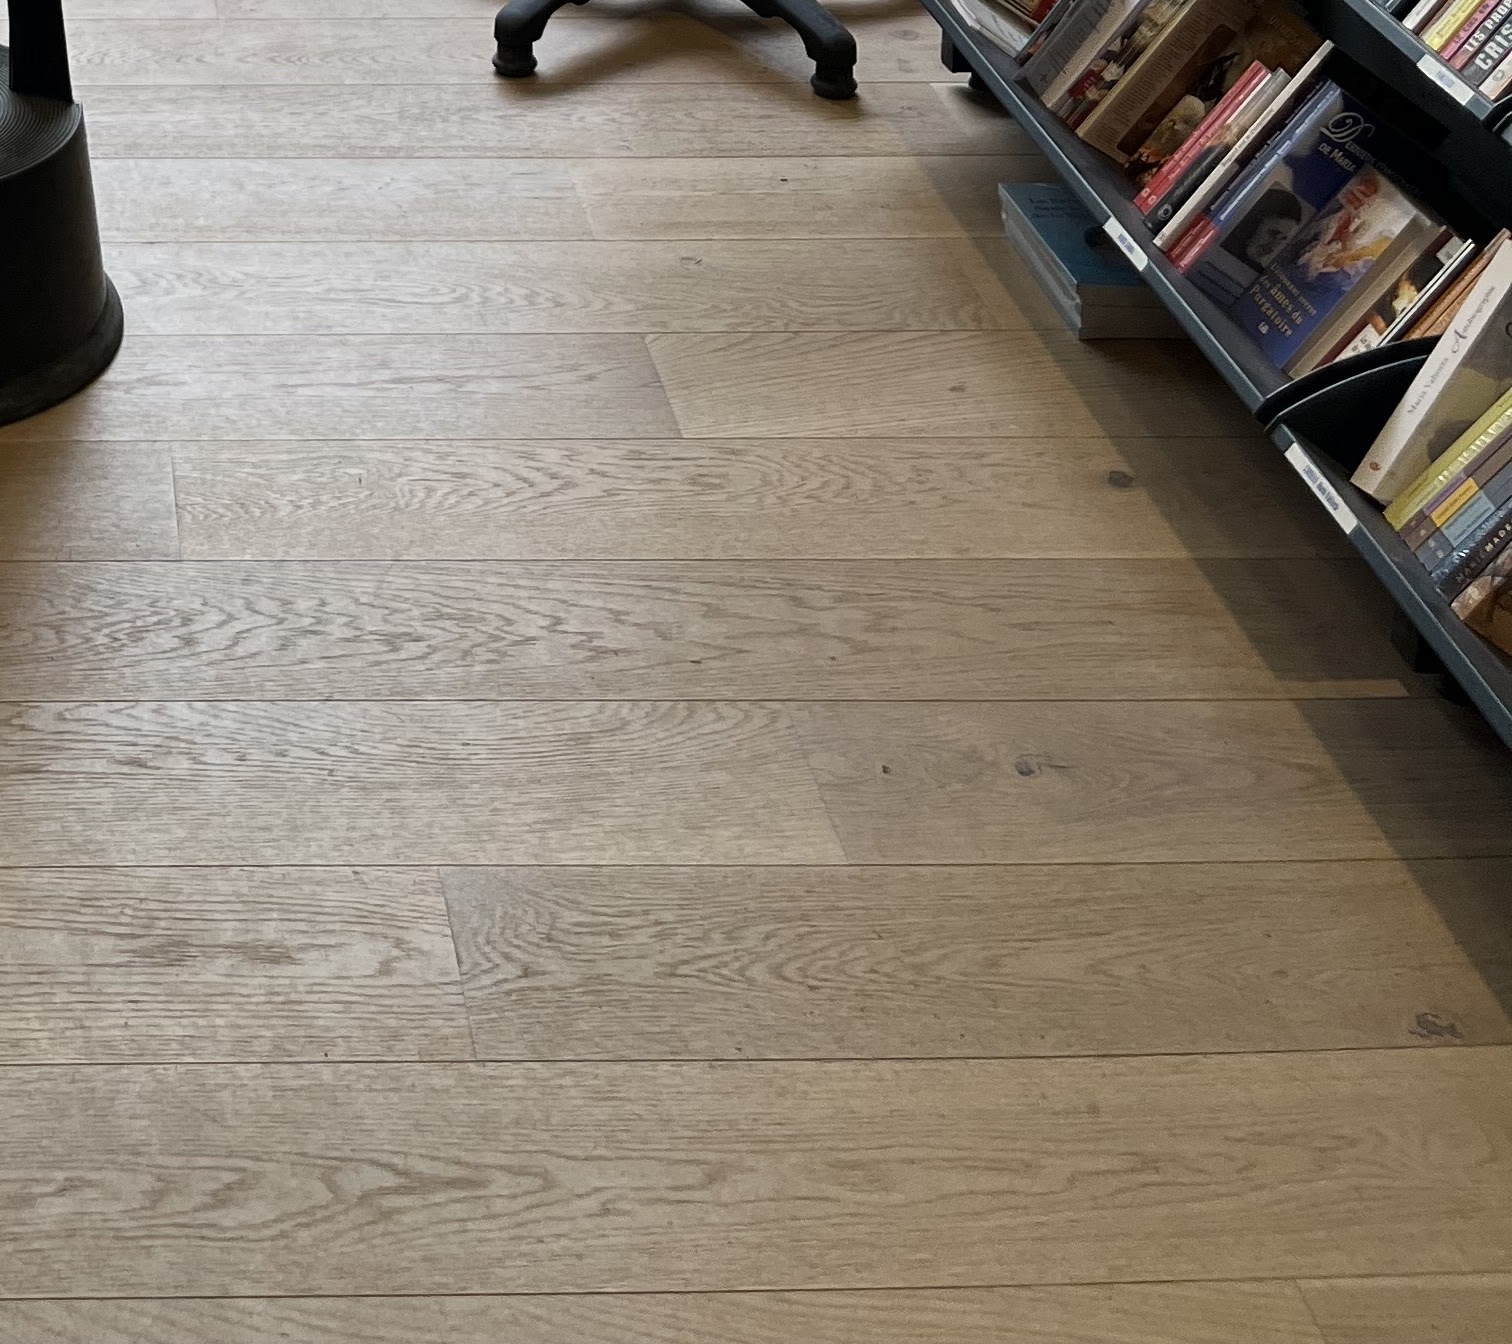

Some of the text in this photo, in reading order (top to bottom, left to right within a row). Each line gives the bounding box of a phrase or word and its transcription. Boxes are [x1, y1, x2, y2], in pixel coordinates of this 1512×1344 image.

[1249, 285, 1294, 337] Purgatoire
[1270, 282, 1294, 313] âmes
[1291, 310, 1305, 326] du
